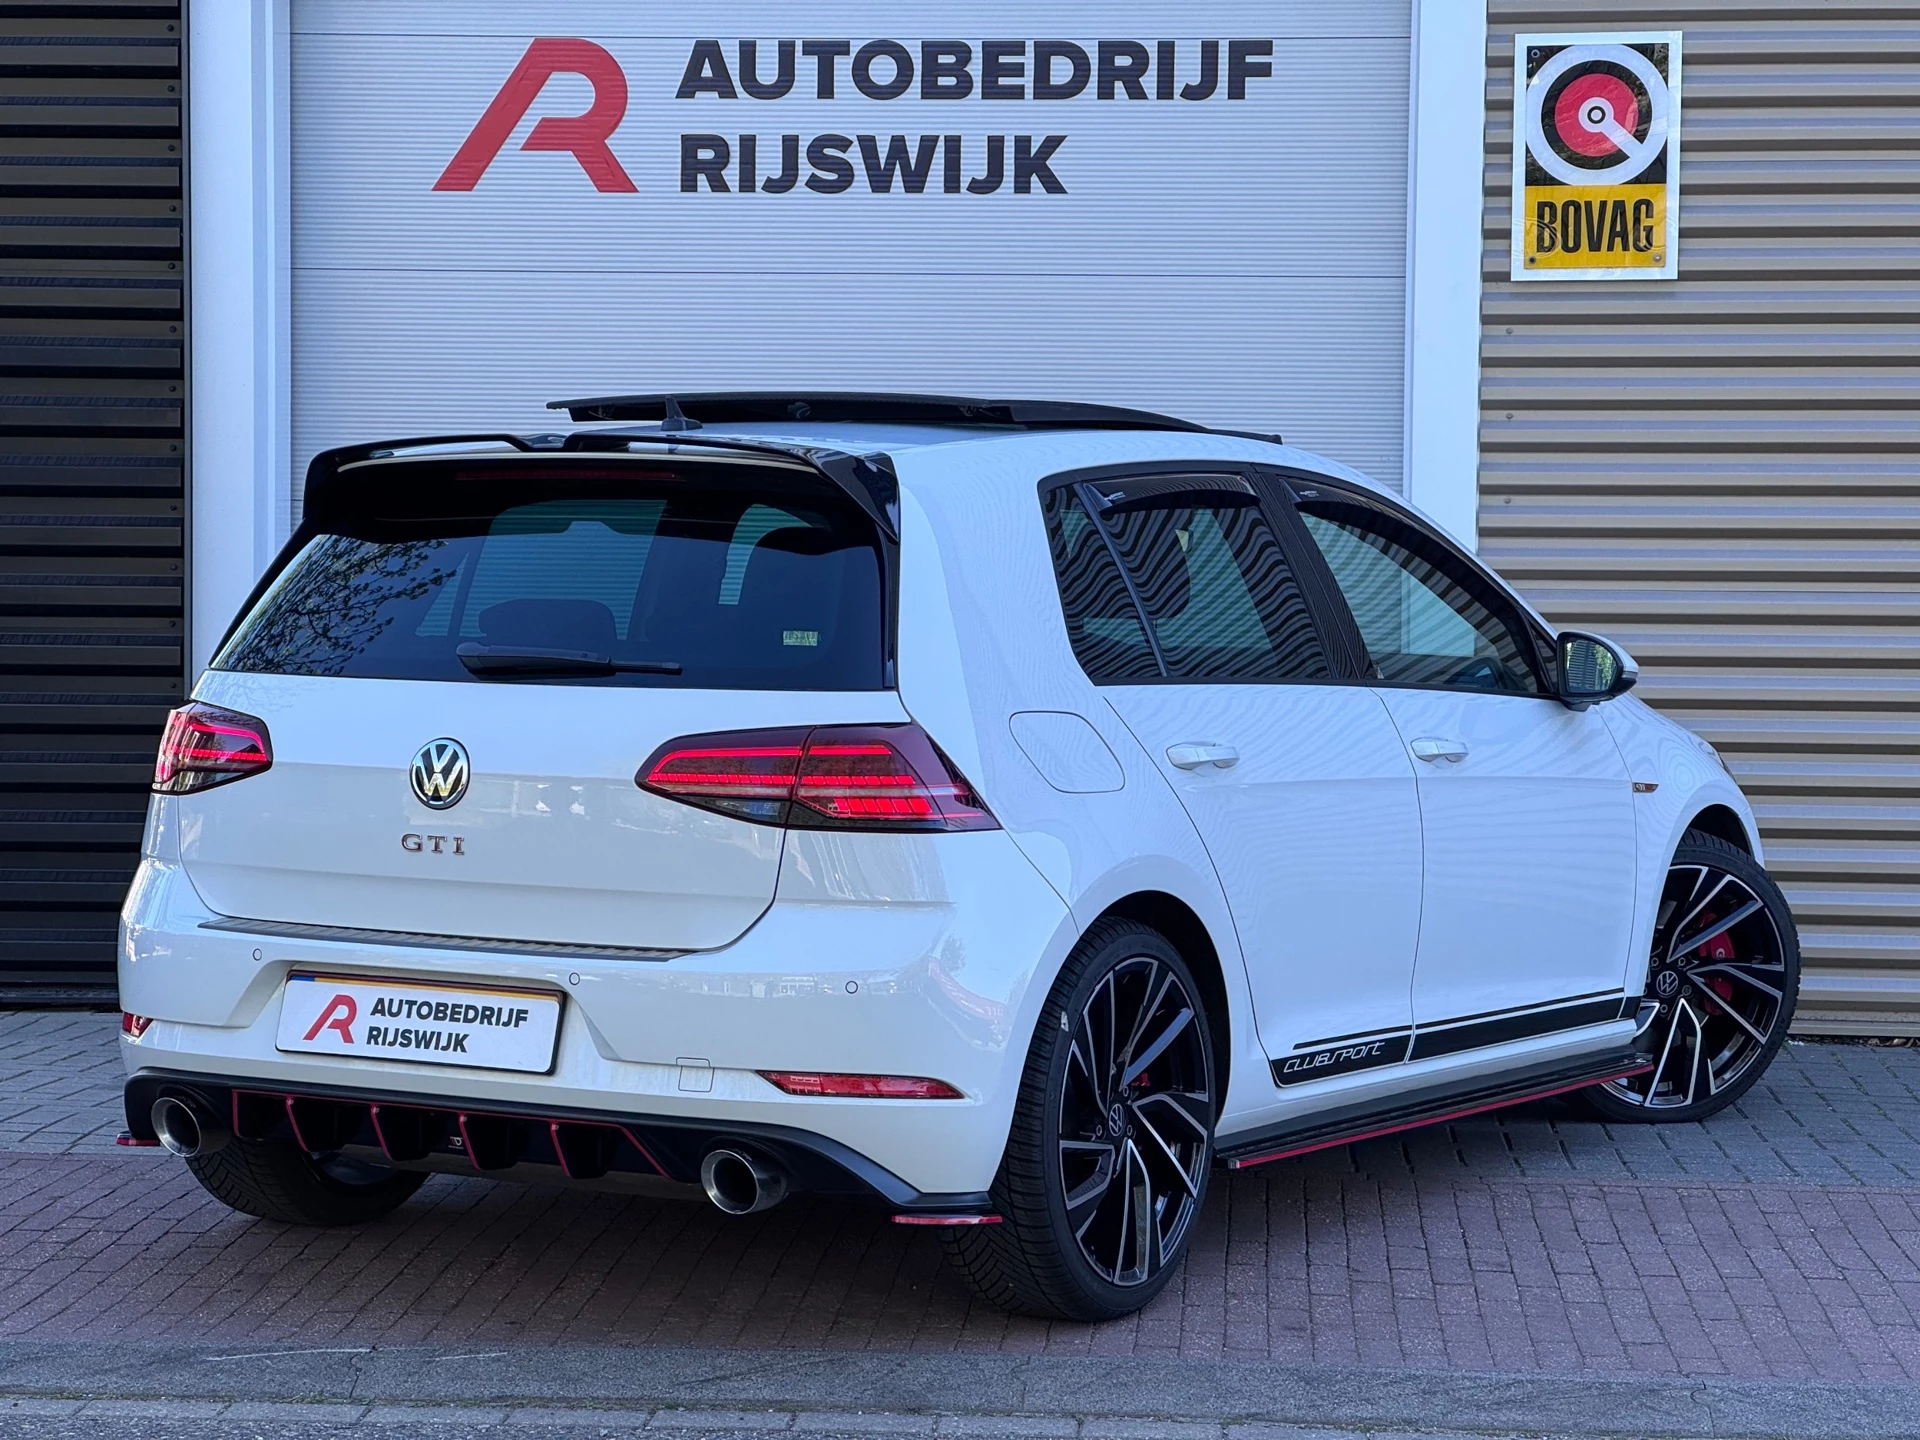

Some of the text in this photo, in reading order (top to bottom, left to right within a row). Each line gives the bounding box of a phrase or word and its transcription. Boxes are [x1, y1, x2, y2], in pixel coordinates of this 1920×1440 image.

[675, 39, 1273, 101] AUTOBEDRIJF
[679, 133, 1068, 194] RIJSWIJK
[1536, 199, 1655, 253] BOVAG
[401, 833, 465, 855] GTI
[370, 998, 529, 1028] AUTOBEDRIJF
[366, 1026, 469, 1053] RIJSWIJK
